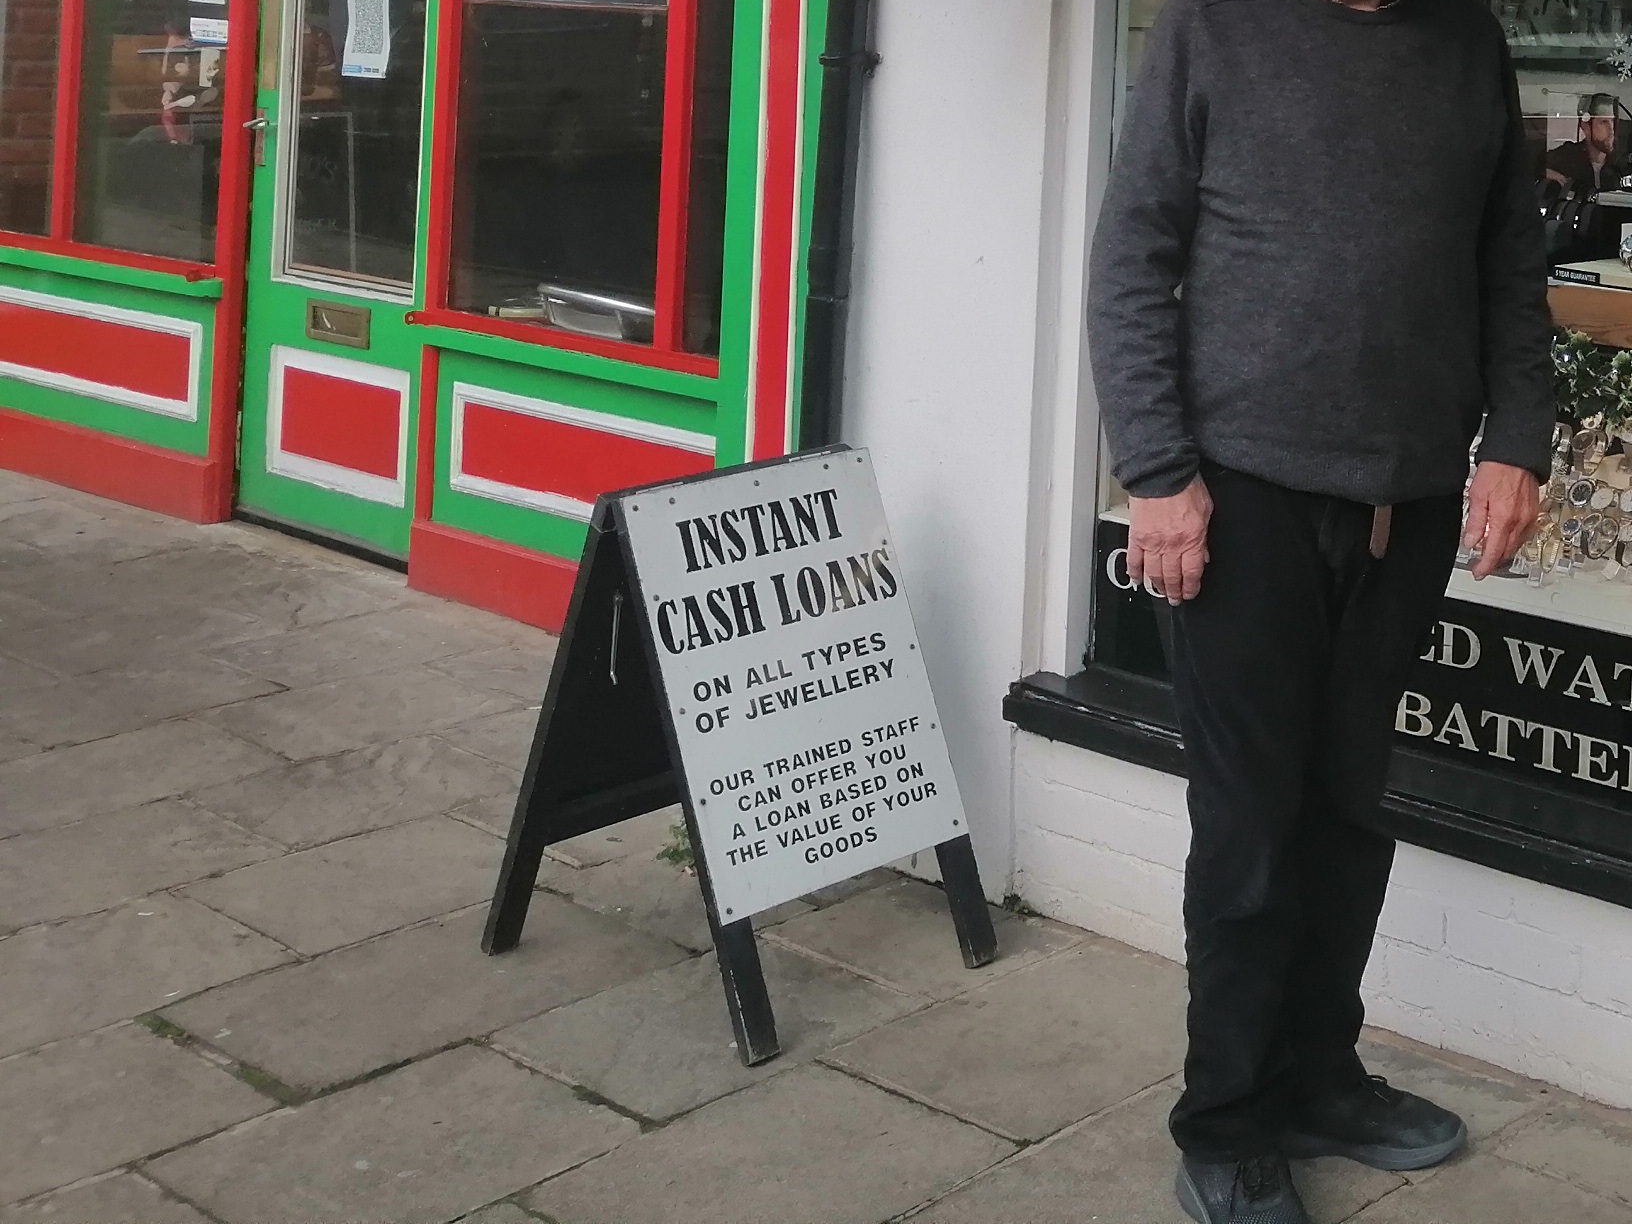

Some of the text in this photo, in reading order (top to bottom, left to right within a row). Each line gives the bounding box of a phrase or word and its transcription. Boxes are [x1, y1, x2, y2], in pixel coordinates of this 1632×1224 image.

[675, 489, 842, 574] INSTANT
[657, 548, 897, 655] CASH LOANS
[693, 632, 887, 702] ON ALL TYPES
[695, 658, 895, 734] OF JEWELLERY
[709, 716, 920, 796] OUR TRAINED STAFF
[738, 744, 907, 812] CAN OFFER YOU
[726, 781, 938, 867] THE VALUE OF YOUR
[732, 762, 925, 841] A LOAN BASED ON
[804, 826, 878, 865] GOODS
